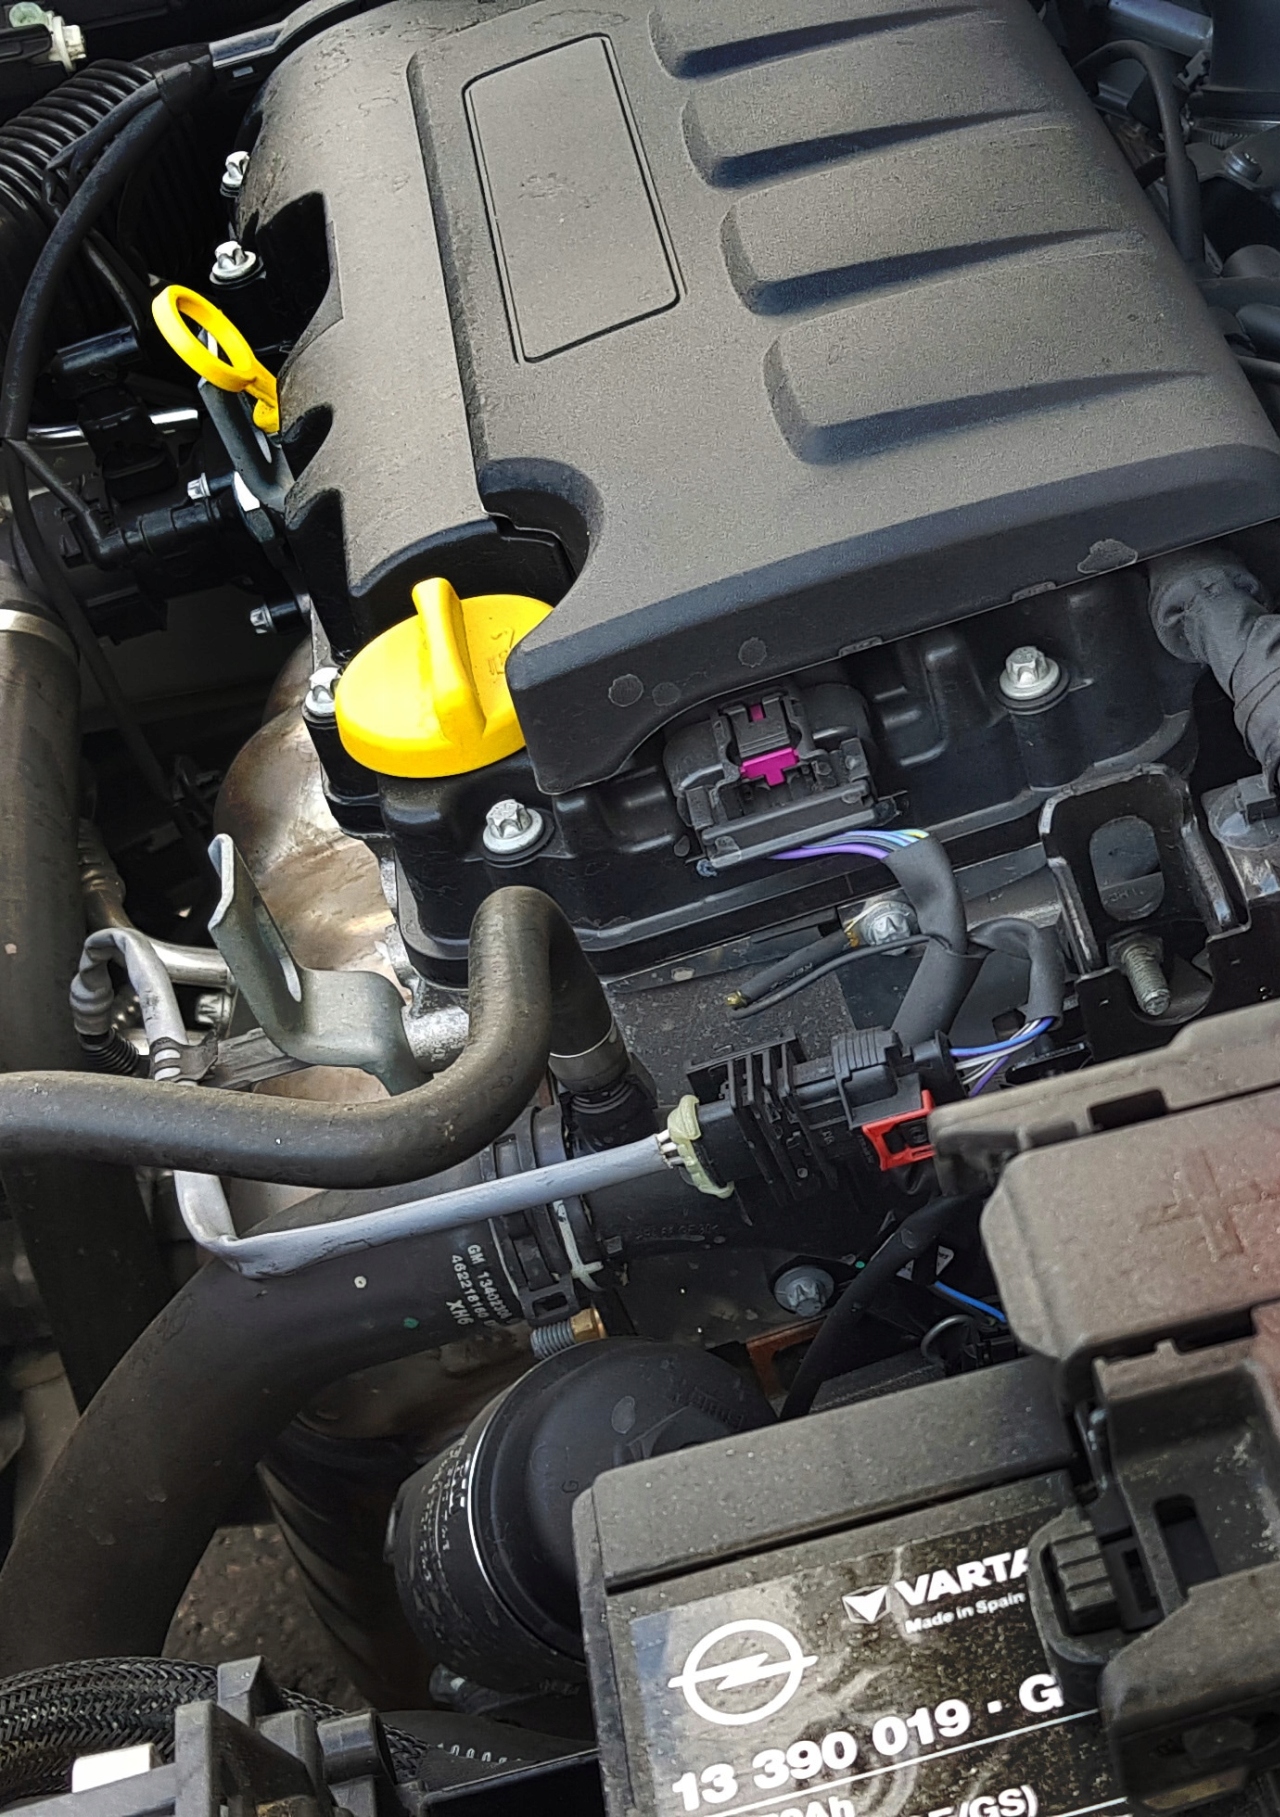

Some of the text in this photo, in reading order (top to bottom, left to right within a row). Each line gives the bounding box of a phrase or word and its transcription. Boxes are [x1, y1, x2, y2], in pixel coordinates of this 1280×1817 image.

[467, 1244, 486, 1265] GM
[446, 1299, 475, 1325] XH6
[905, 1591, 1026, 1634] Made in Spain
[672, 1764, 738, 1812] 13
[752, 1731, 857, 1790] 390
[871, 1698, 970, 1756] 019
[1018, 1673, 1064, 1713] G
